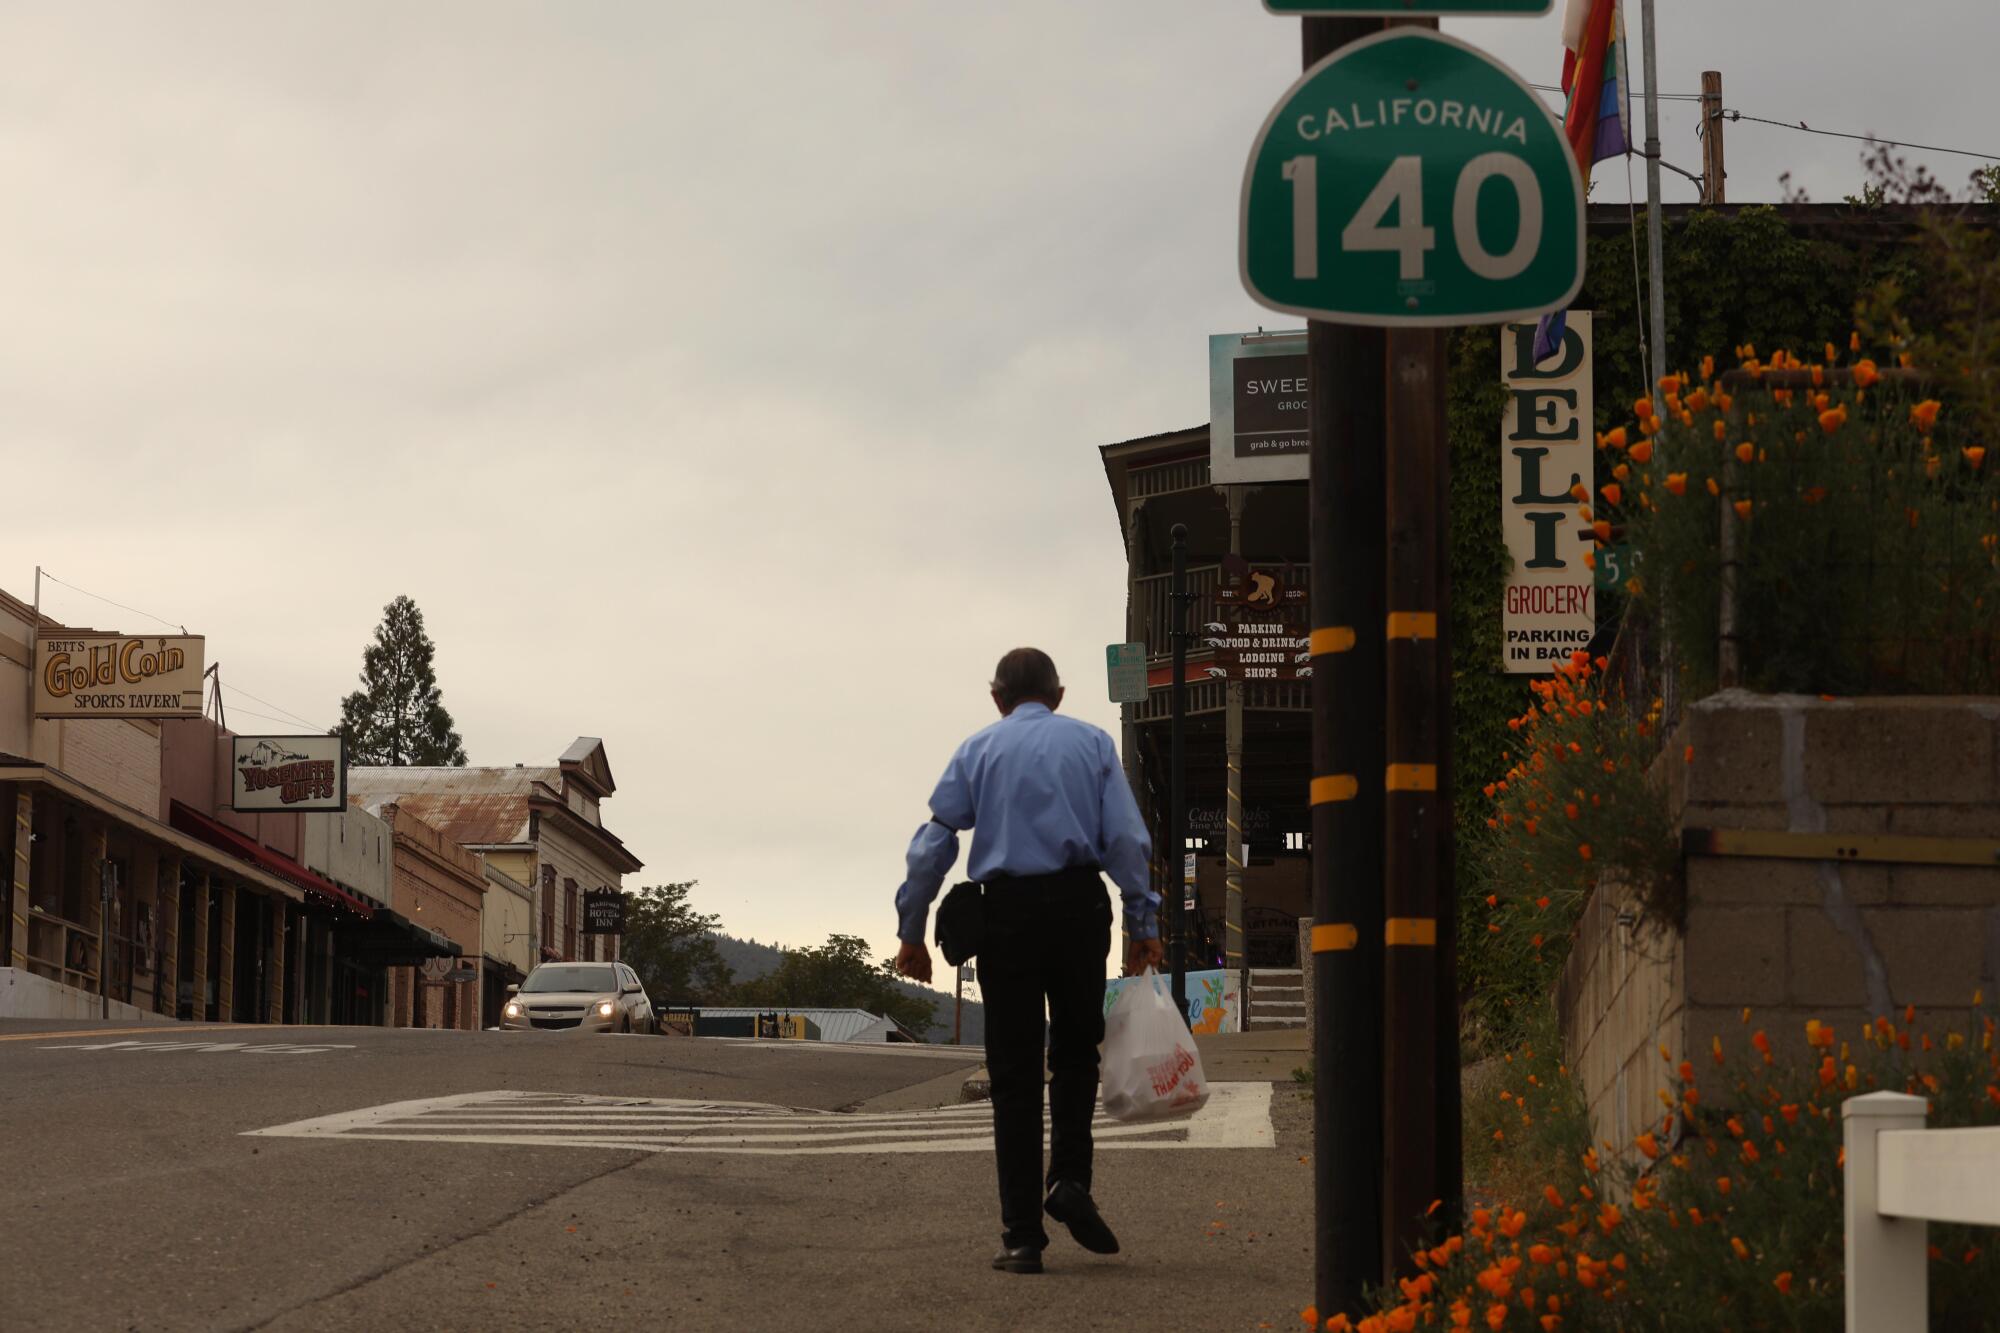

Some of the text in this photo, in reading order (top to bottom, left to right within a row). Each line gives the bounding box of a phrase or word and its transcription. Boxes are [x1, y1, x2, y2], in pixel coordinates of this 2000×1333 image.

[1297, 98, 1527, 145] CALIFORNIA
[1282, 151, 1543, 280] 140
[1250, 440, 1269, 451] grab
[1270, 440, 1278, 448] &
[1279, 441, 1290, 449] go
[1506, 324, 1585, 569] DELI
[1507, 585, 1591, 615] GROCERY
[1238, 623, 1284, 634] PARKING
[1507, 630, 1590, 642] PARKING
[47, 640, 85, 652] BETT'S
[1226, 637, 1296, 648] FOOD & DRINK
[1239, 652, 1285, 663] LODGING
[1511, 647, 1530, 660] IN
[44, 638, 185, 698] Gold Coin
[1244, 668, 1278, 678] SHOPS
[74, 693, 181, 709] SPORTS TAVERN
[238, 760, 335, 792] YOSEMITE
[280, 780, 334, 804] GIFTS
[589, 909, 620, 918] HOTEL
[596, 918, 613, 927] INN
